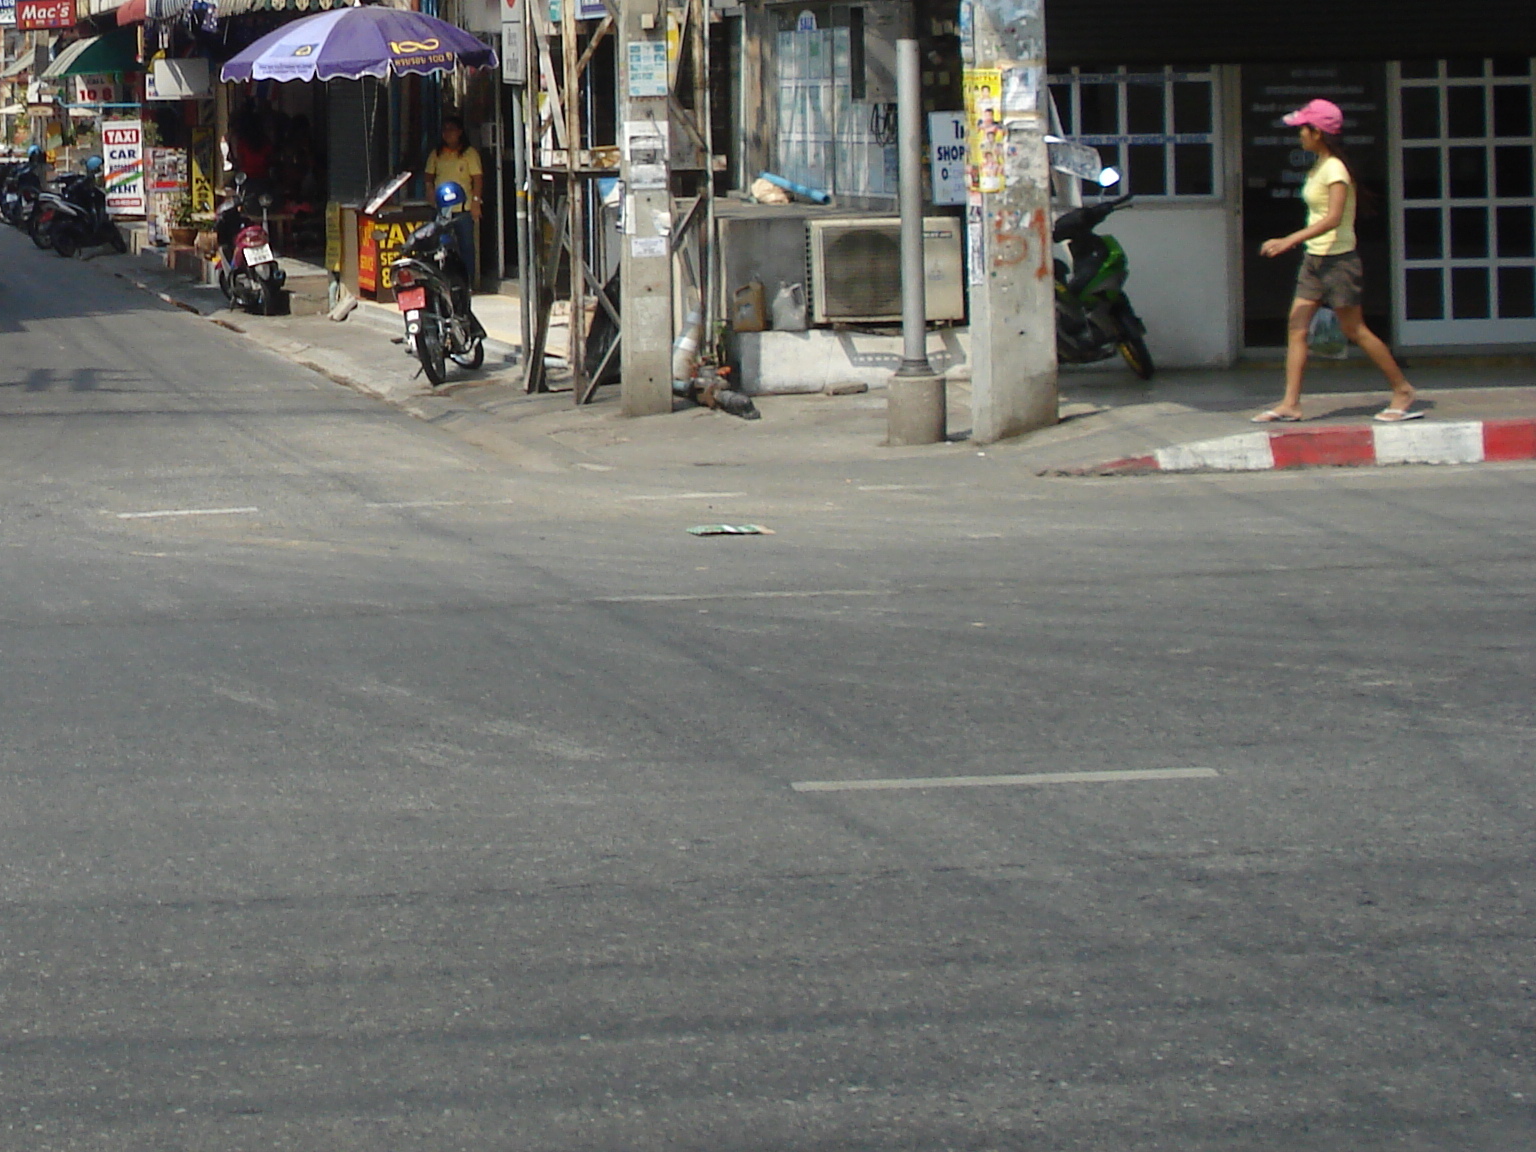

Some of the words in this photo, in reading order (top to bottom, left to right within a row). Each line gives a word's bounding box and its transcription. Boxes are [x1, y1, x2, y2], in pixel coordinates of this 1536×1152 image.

[21, 3, 71, 20] Mac's
[428, 54, 445, 64] 100
[106, 129, 138, 144] TAXI
[109, 149, 137, 160] CAR
[937, 145, 965, 161] SHOP
[110, 184, 138, 194] RENT
